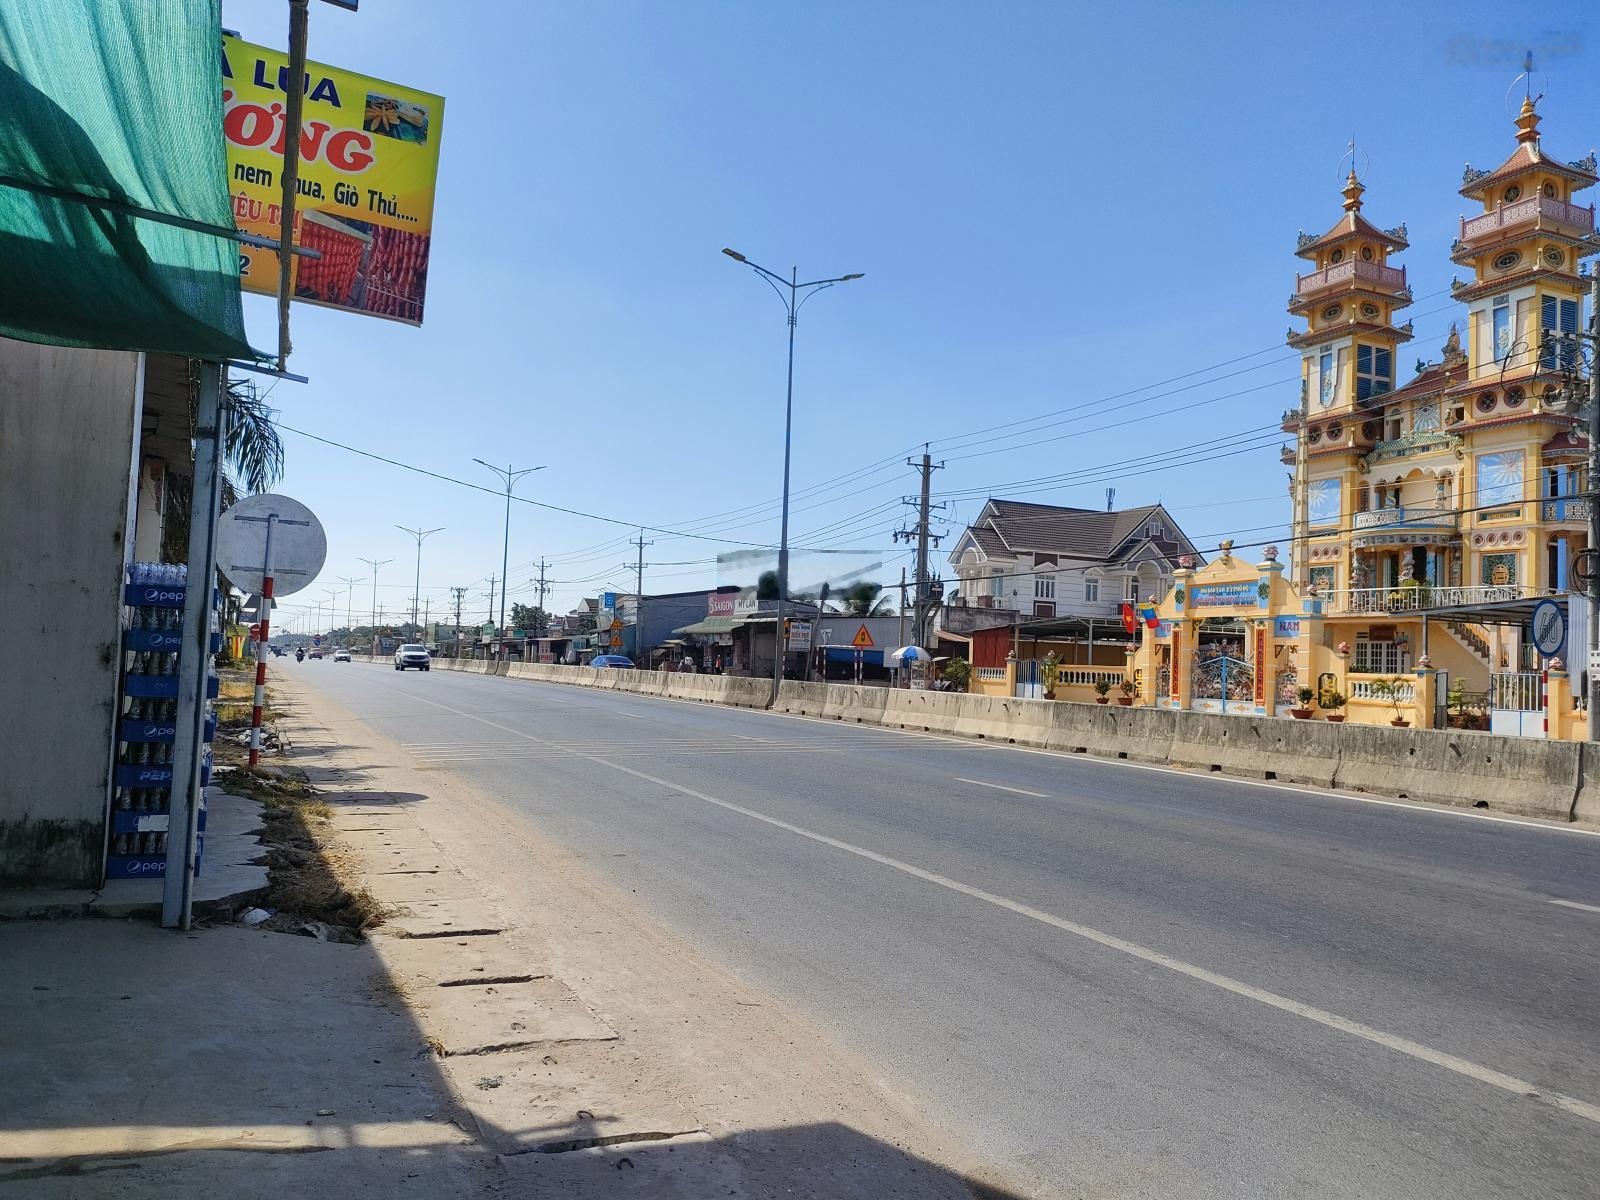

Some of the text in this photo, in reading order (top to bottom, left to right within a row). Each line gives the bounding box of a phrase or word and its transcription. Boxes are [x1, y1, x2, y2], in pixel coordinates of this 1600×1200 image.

[234, 163, 273, 187] nem
[334, 182, 359, 208] Giò
[268, 203, 300, 235] TỊ
[1280, 621, 1300, 632] NAM
